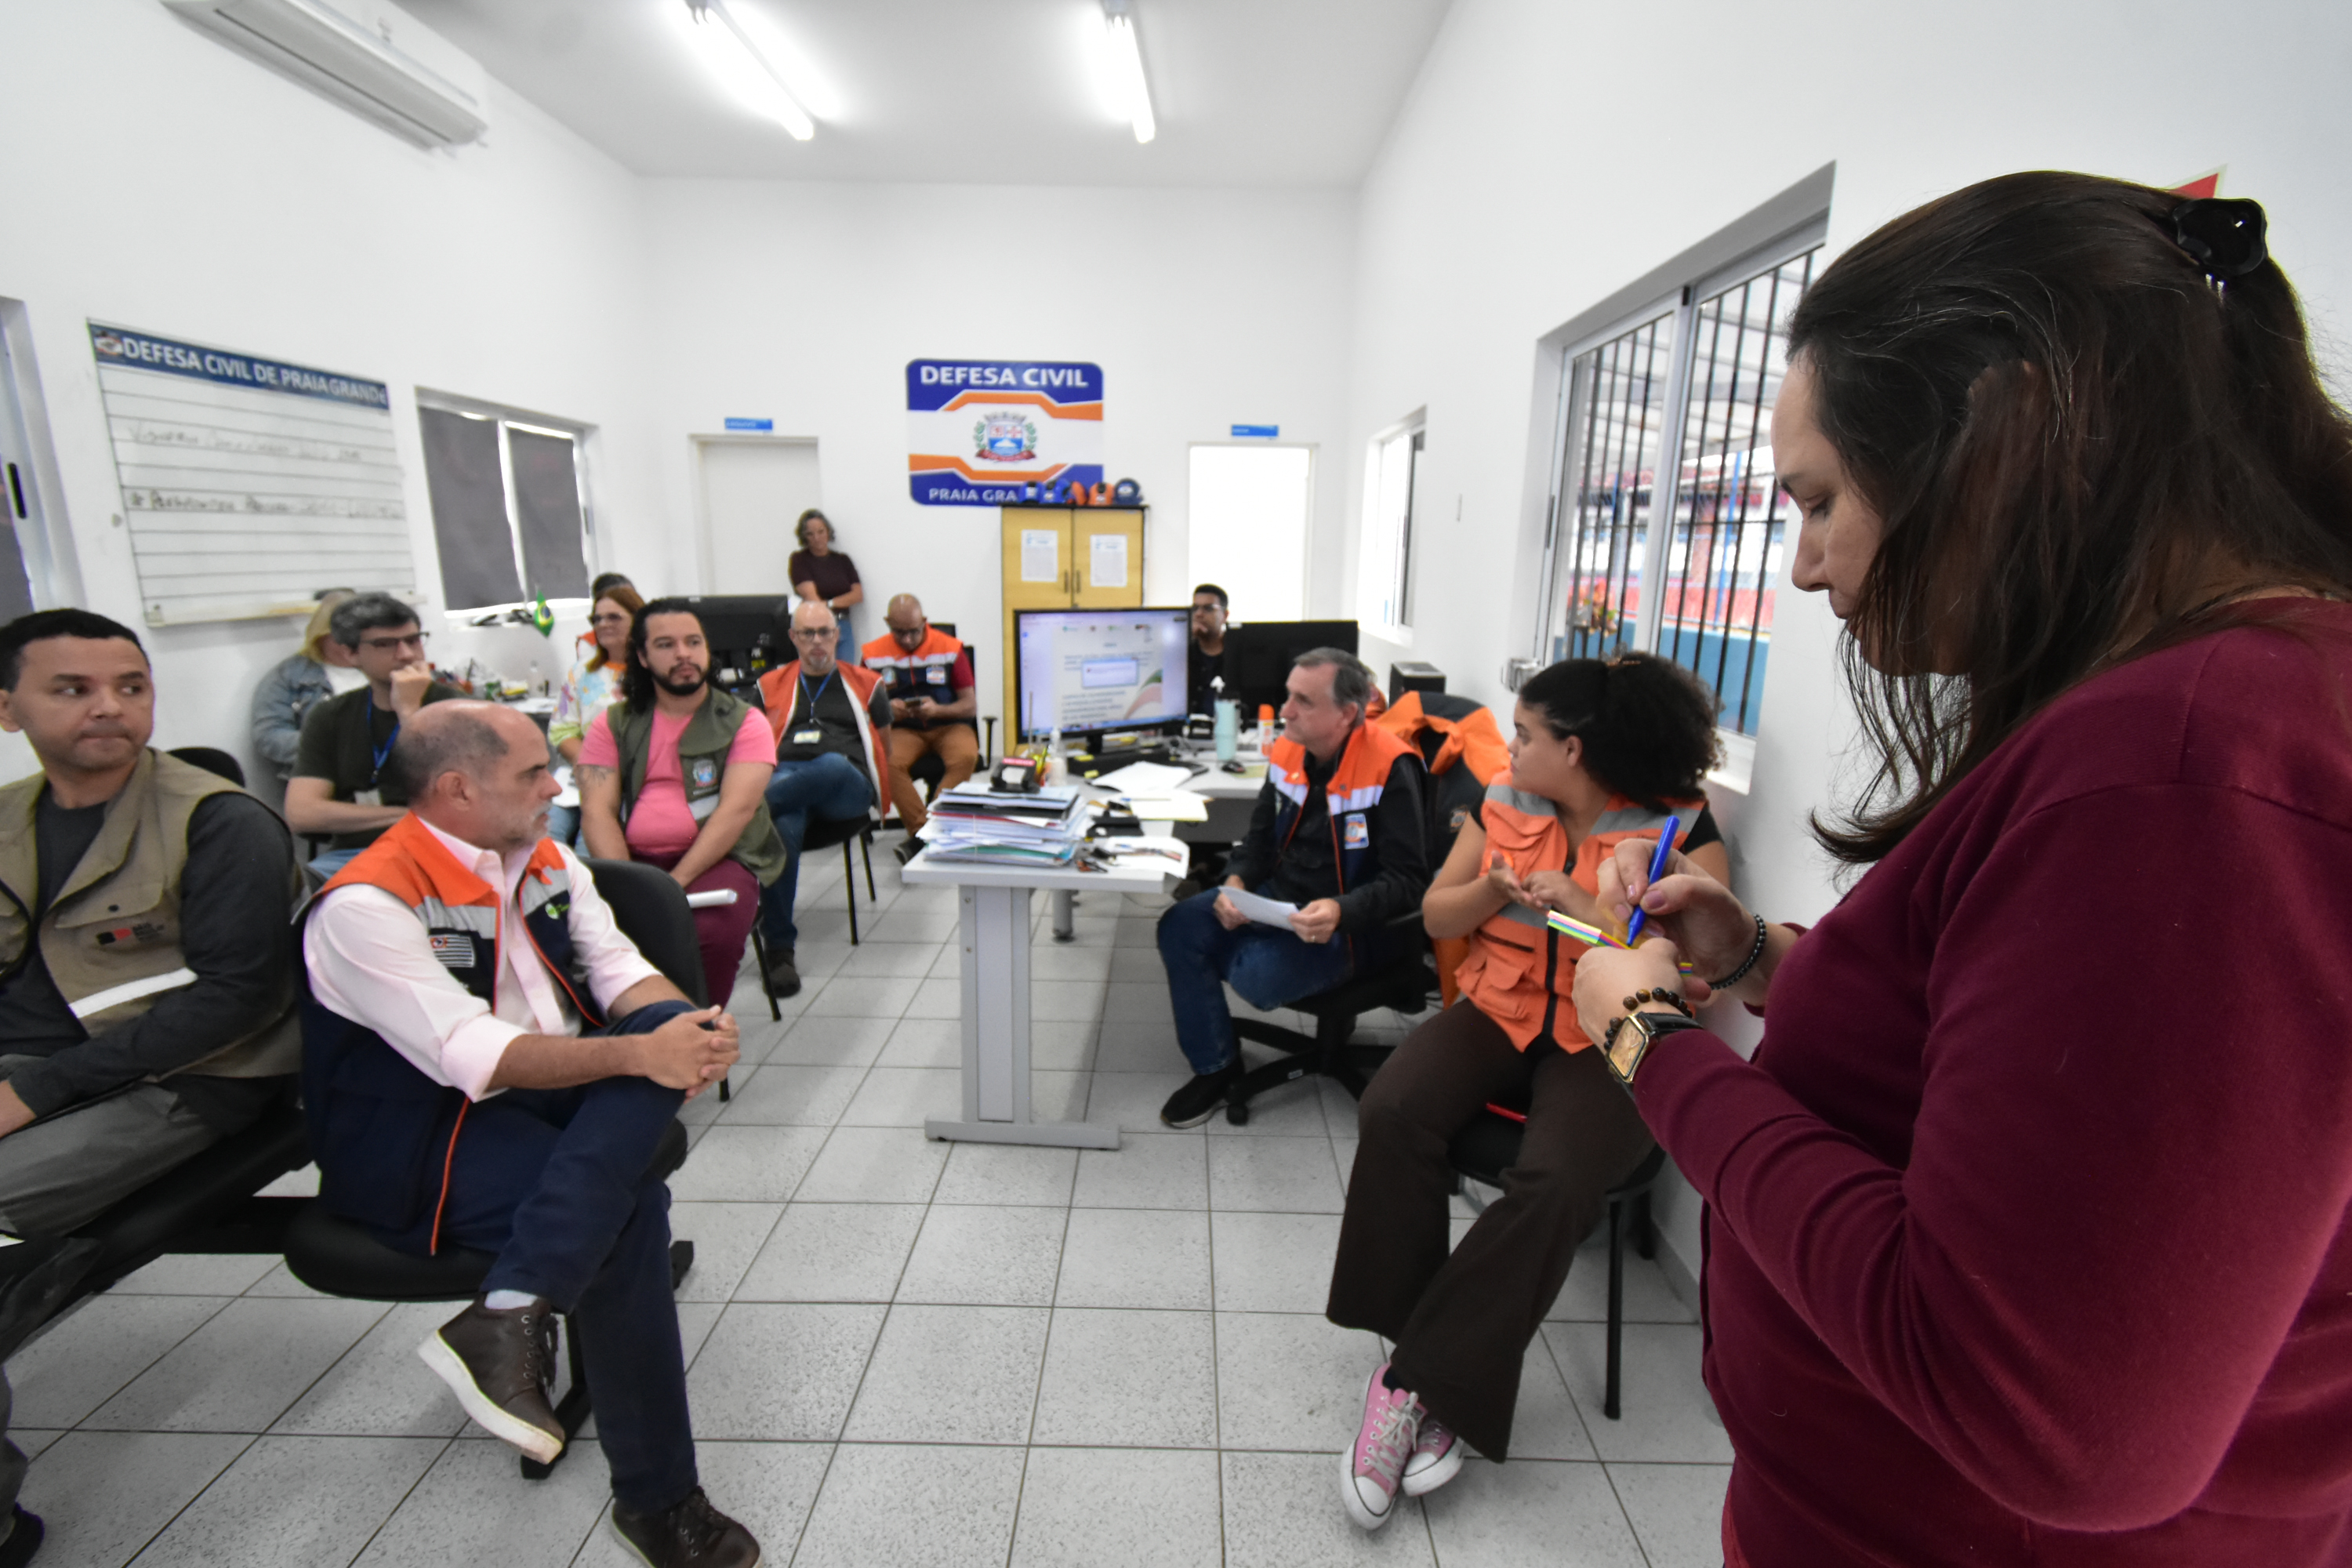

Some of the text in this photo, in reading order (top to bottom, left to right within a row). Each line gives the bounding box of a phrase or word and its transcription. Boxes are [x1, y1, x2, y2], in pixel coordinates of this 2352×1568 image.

[122, 336, 387, 405] DEFESA CIVIL DE PRAIA GRANDE
[920, 365, 1088, 387] DEFESA CIVIL
[928, 488, 1018, 503] PRAIA GRA
